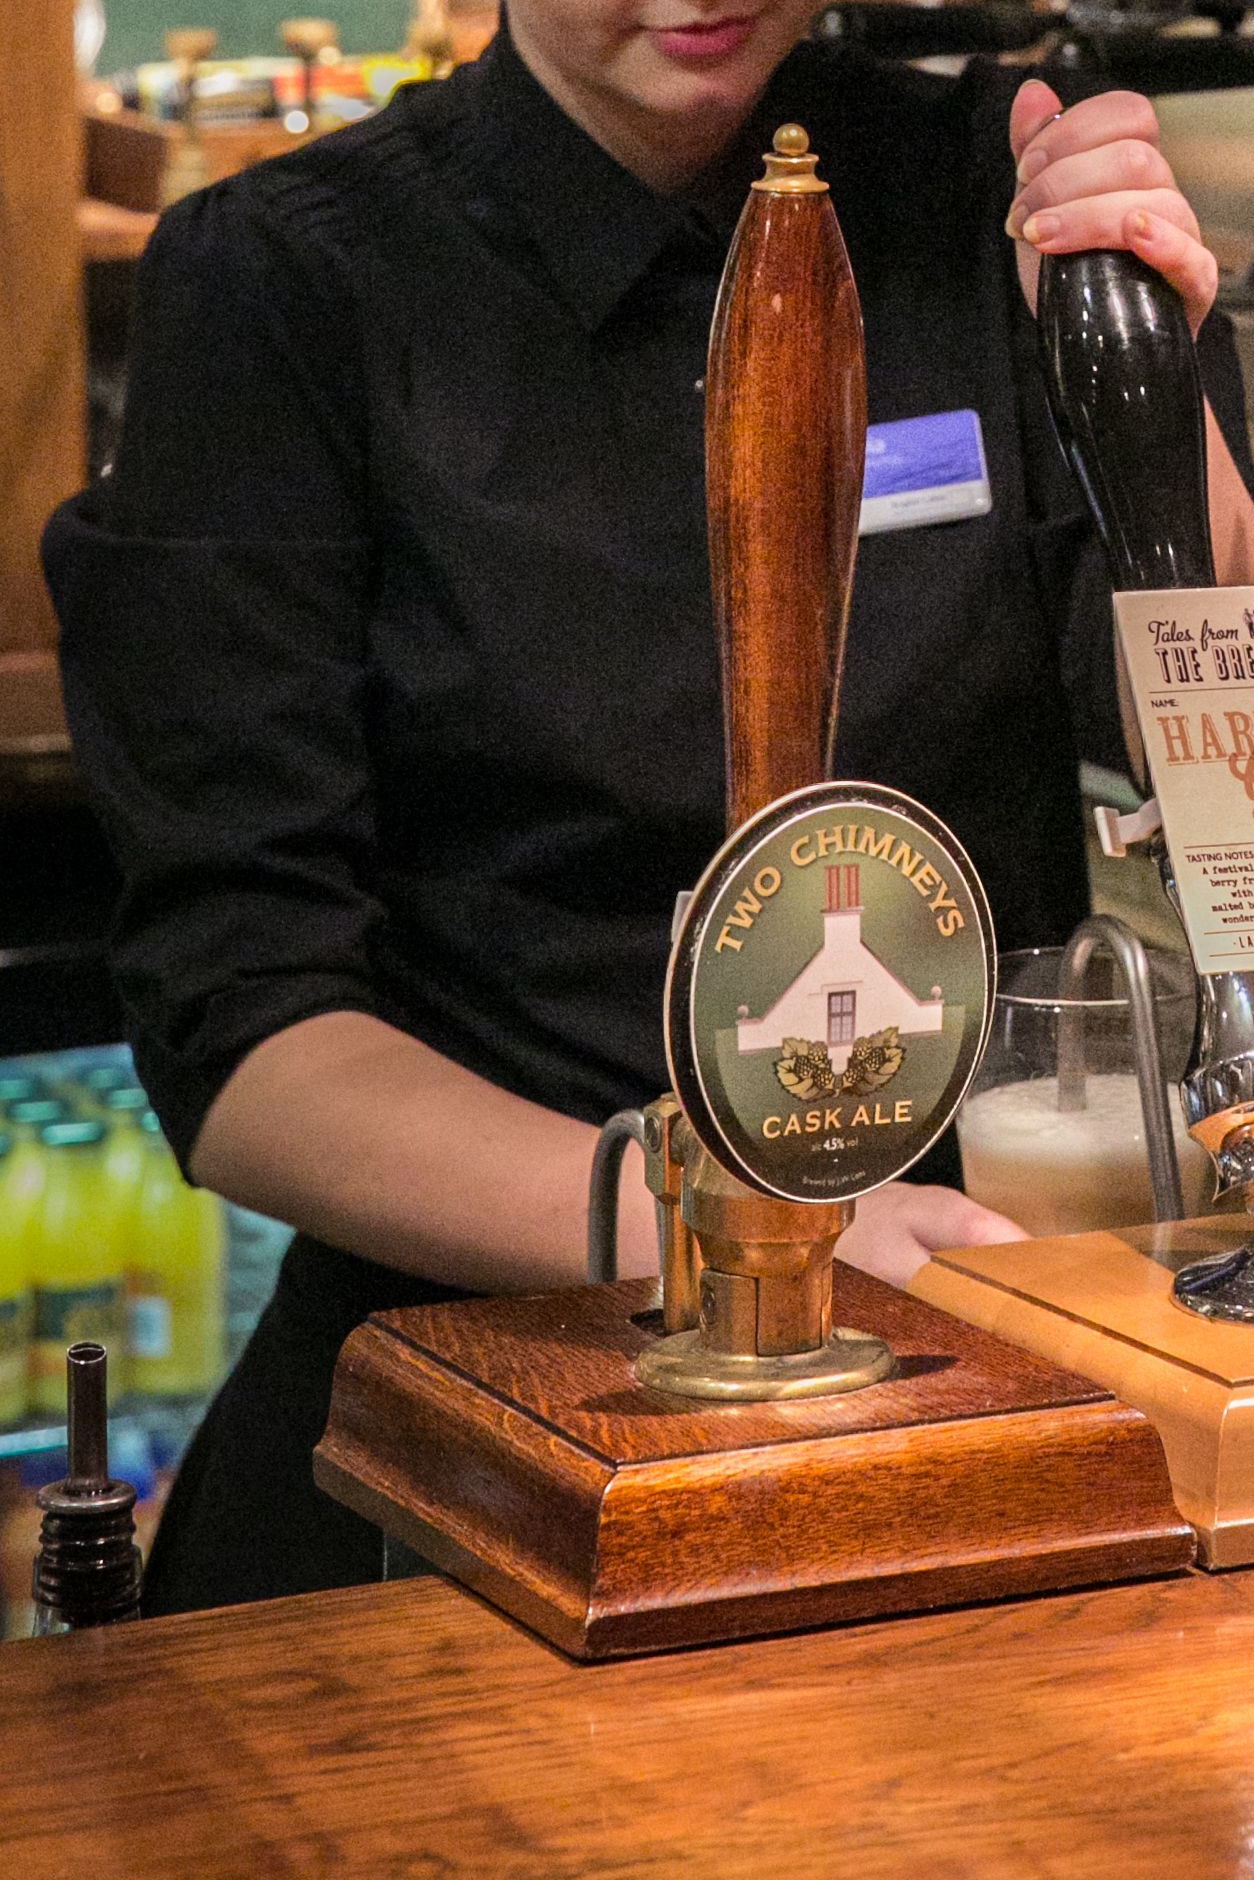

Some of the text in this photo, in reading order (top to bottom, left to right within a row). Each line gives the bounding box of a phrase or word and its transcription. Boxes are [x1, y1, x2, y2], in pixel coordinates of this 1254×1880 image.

[1148, 619, 1239, 651] Tales from
[1154, 646, 1204, 684] THE
[1186, 852, 1223, 864] TASTING
[1202, 867, 1209, 876] A
[1213, 863, 1254, 876] festival
[714, 824, 967, 955] TWO CHIMNEYS
[1209, 877, 1238, 889] berry
[1231, 888, 1254, 898] with
[1211, 901, 1243, 912] malted
[762, 1099, 914, 1139] CASK ALE
